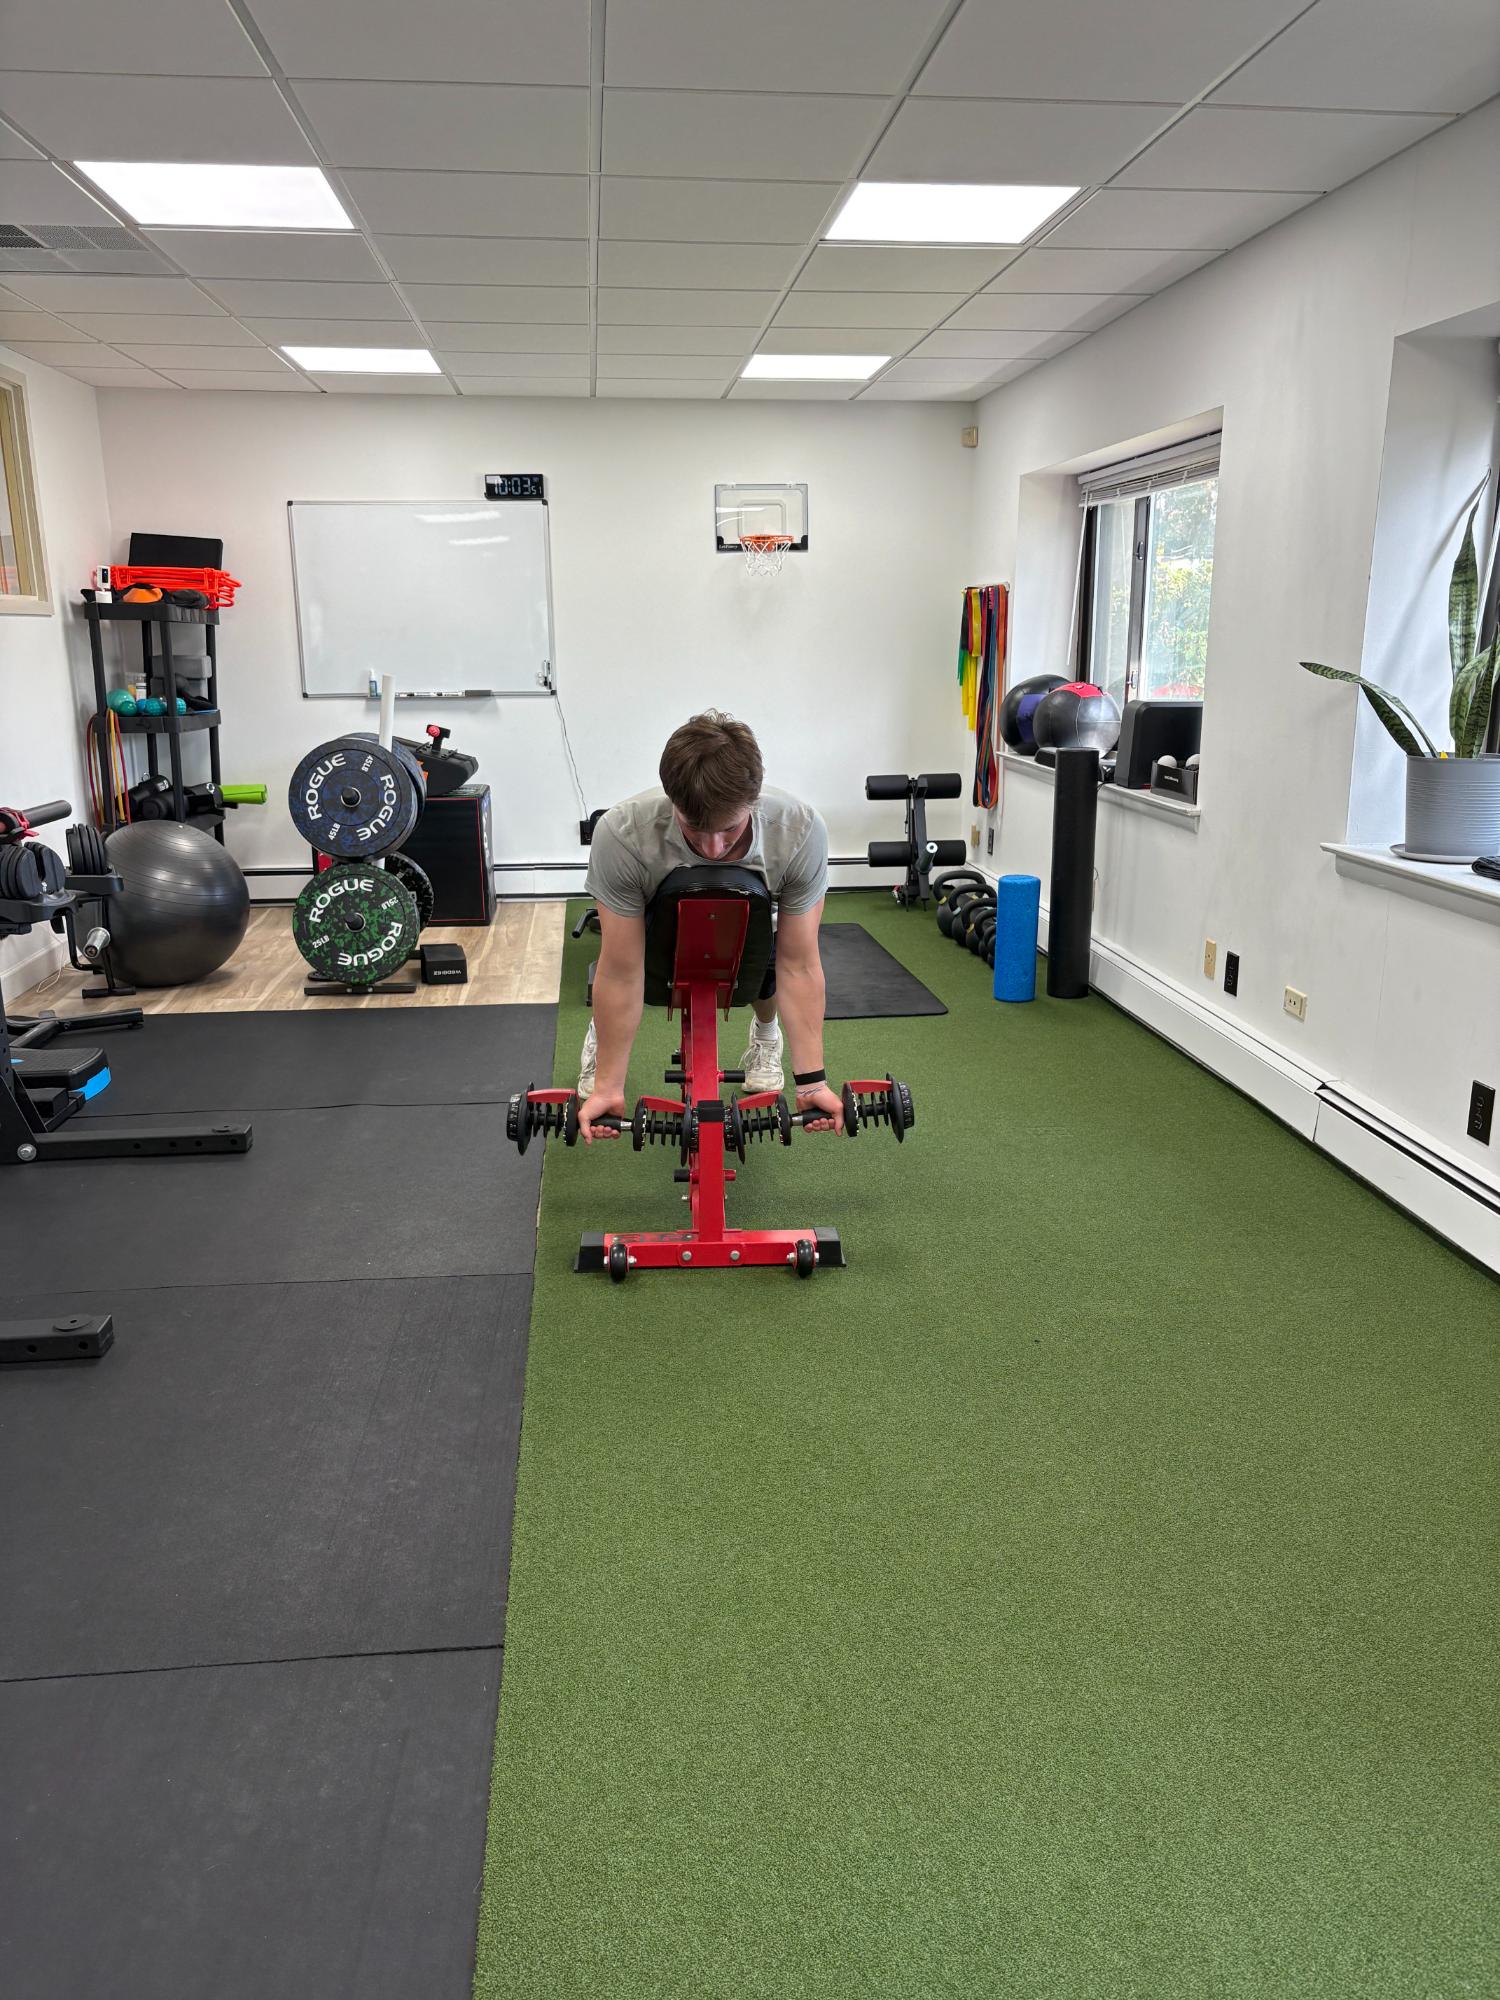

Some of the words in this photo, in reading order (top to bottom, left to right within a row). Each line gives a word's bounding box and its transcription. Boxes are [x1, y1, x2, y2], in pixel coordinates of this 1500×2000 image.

[494, 477, 531, 496] 10:03
[361, 755, 374, 773] 45LB
[305, 753, 347, 821] ROGUE
[356, 774, 397, 841] ROGUE
[328, 823, 341, 841] 45LB
[308, 878, 375, 923] ROGUE
[381, 896, 399, 911] 25LB
[312, 934, 330, 949] 25LB
[337, 921, 403, 967] ROGUE
